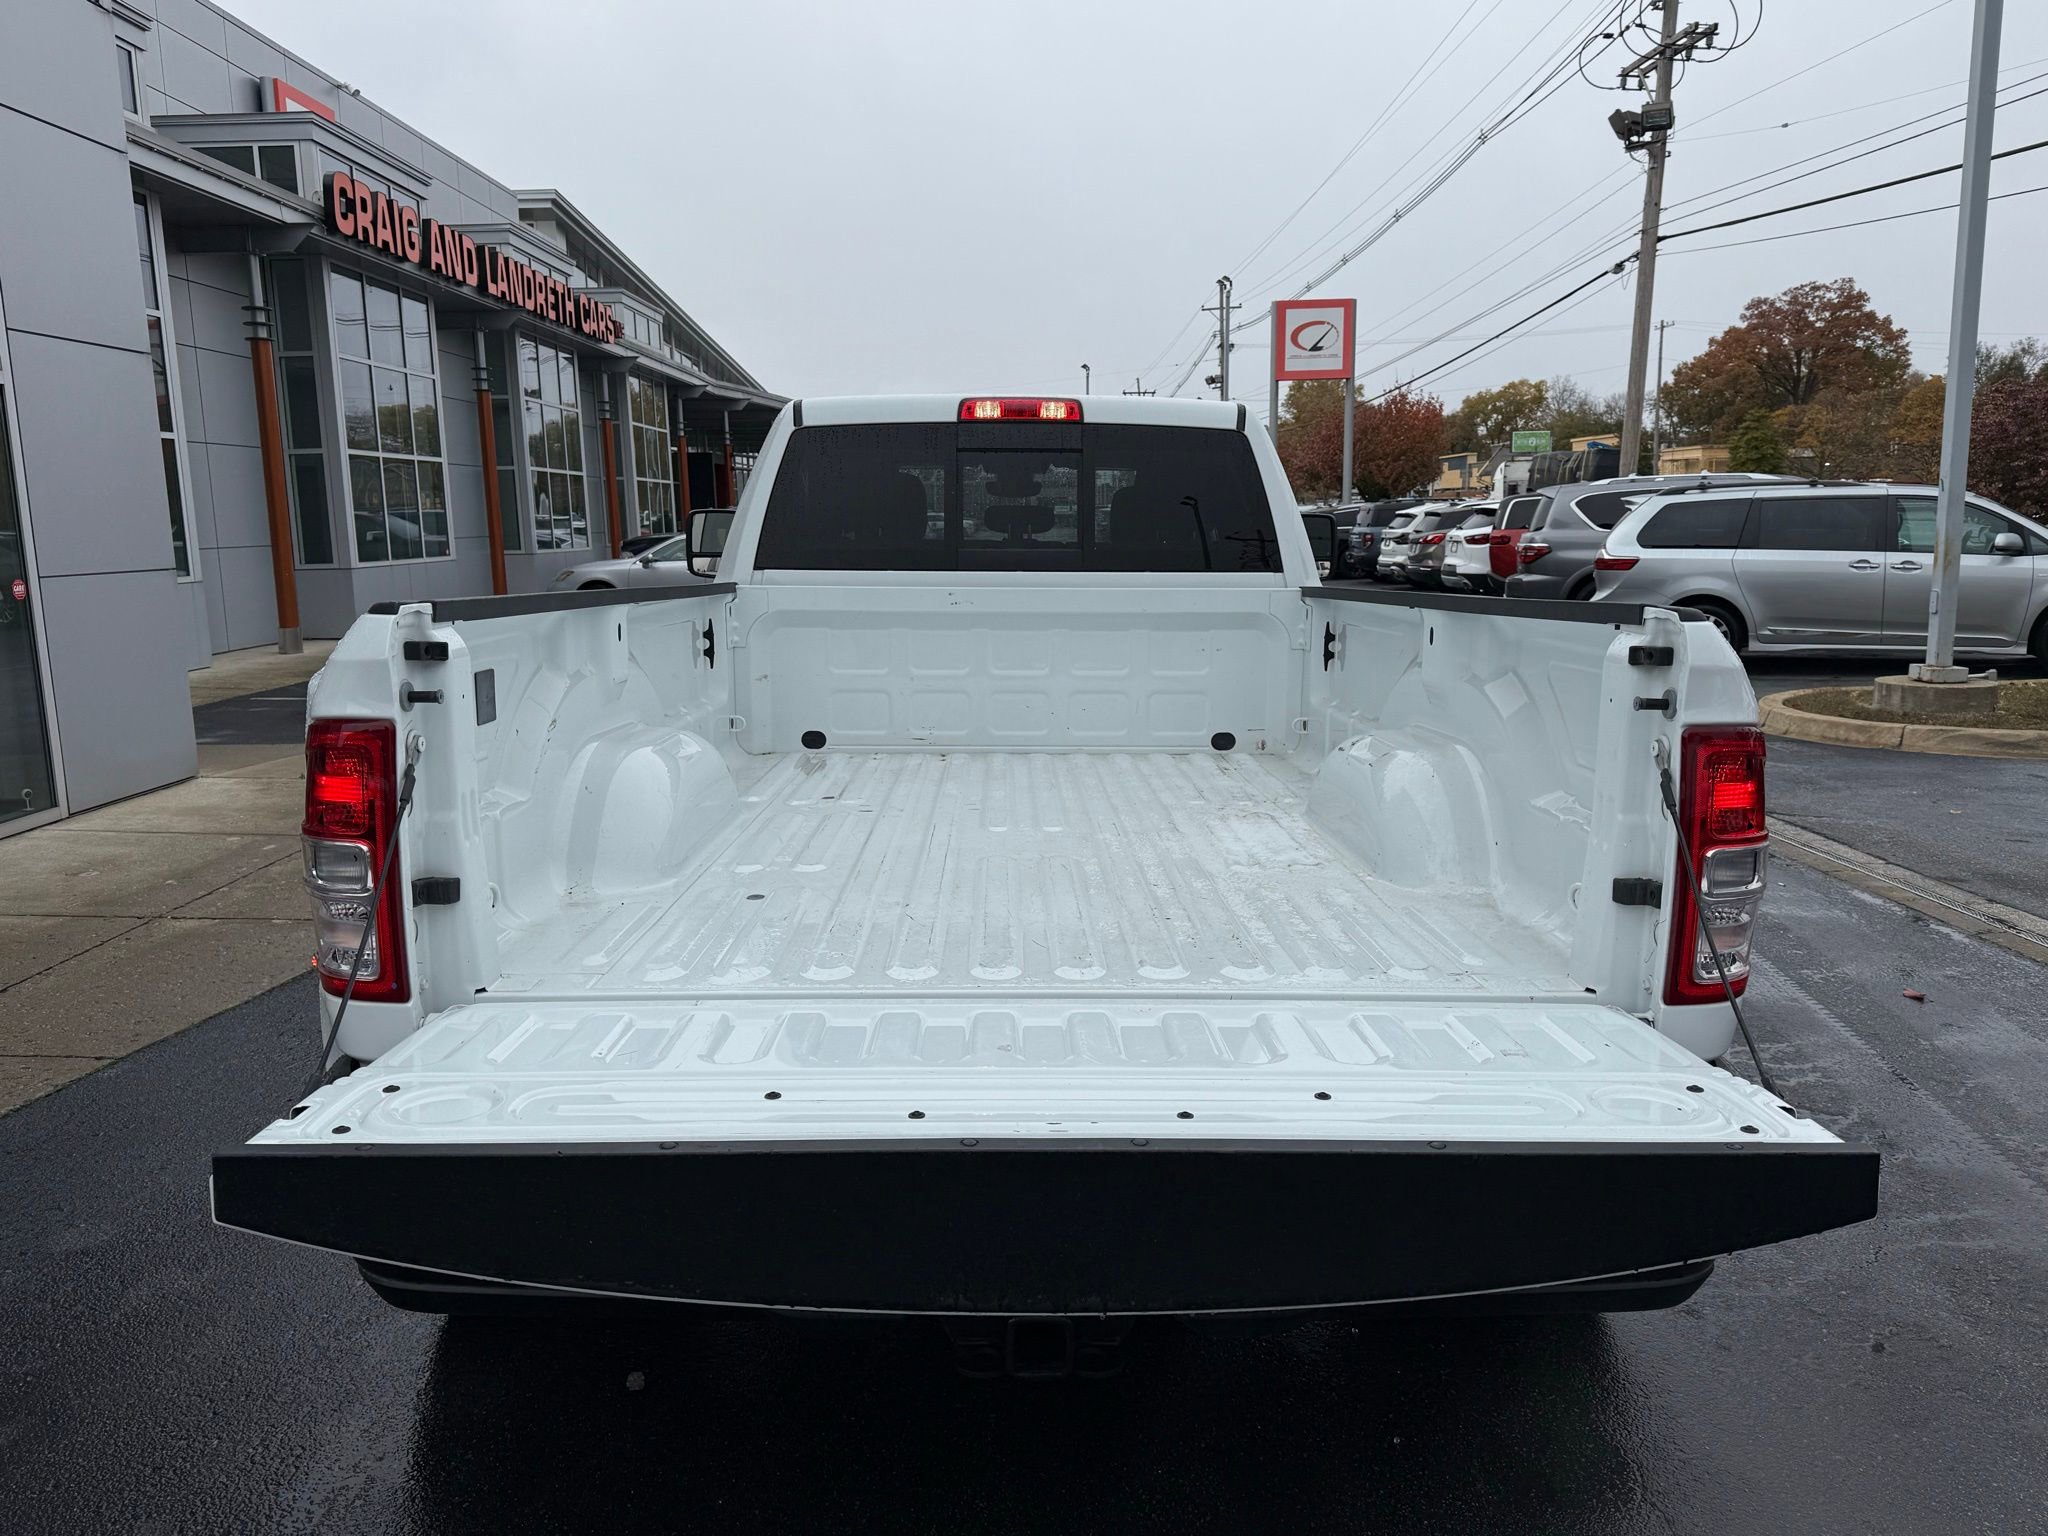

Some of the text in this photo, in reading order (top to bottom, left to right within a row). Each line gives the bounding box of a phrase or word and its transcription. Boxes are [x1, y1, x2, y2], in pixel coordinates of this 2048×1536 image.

[333, 171, 615, 344] CRAIG AND LANDRETH CARS
